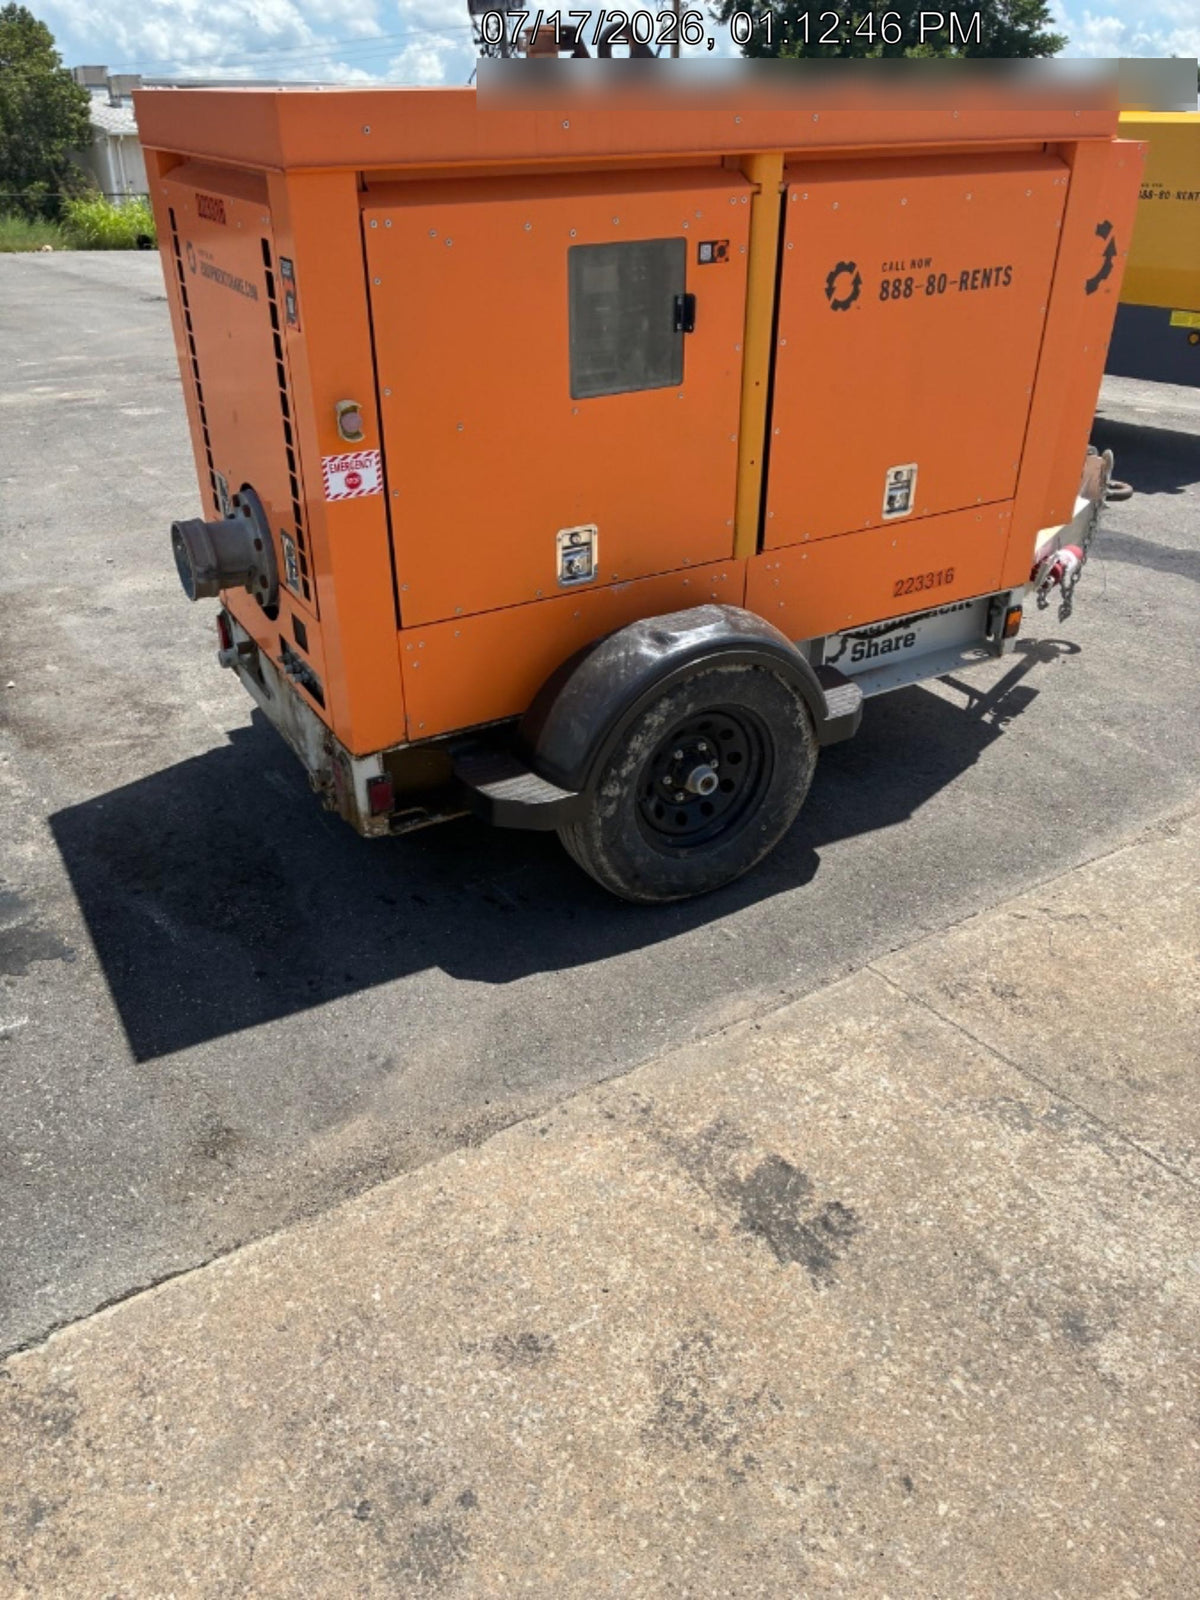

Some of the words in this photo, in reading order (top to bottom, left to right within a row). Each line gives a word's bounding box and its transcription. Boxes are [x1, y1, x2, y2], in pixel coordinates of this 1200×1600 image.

[881, 262, 906, 272] CALL
[910, 257, 933, 269] NOW
[879, 265, 1013, 301] 888-80-RENTS
[894, 567, 955, 597] 223316
[851, 632, 917, 662] Share
